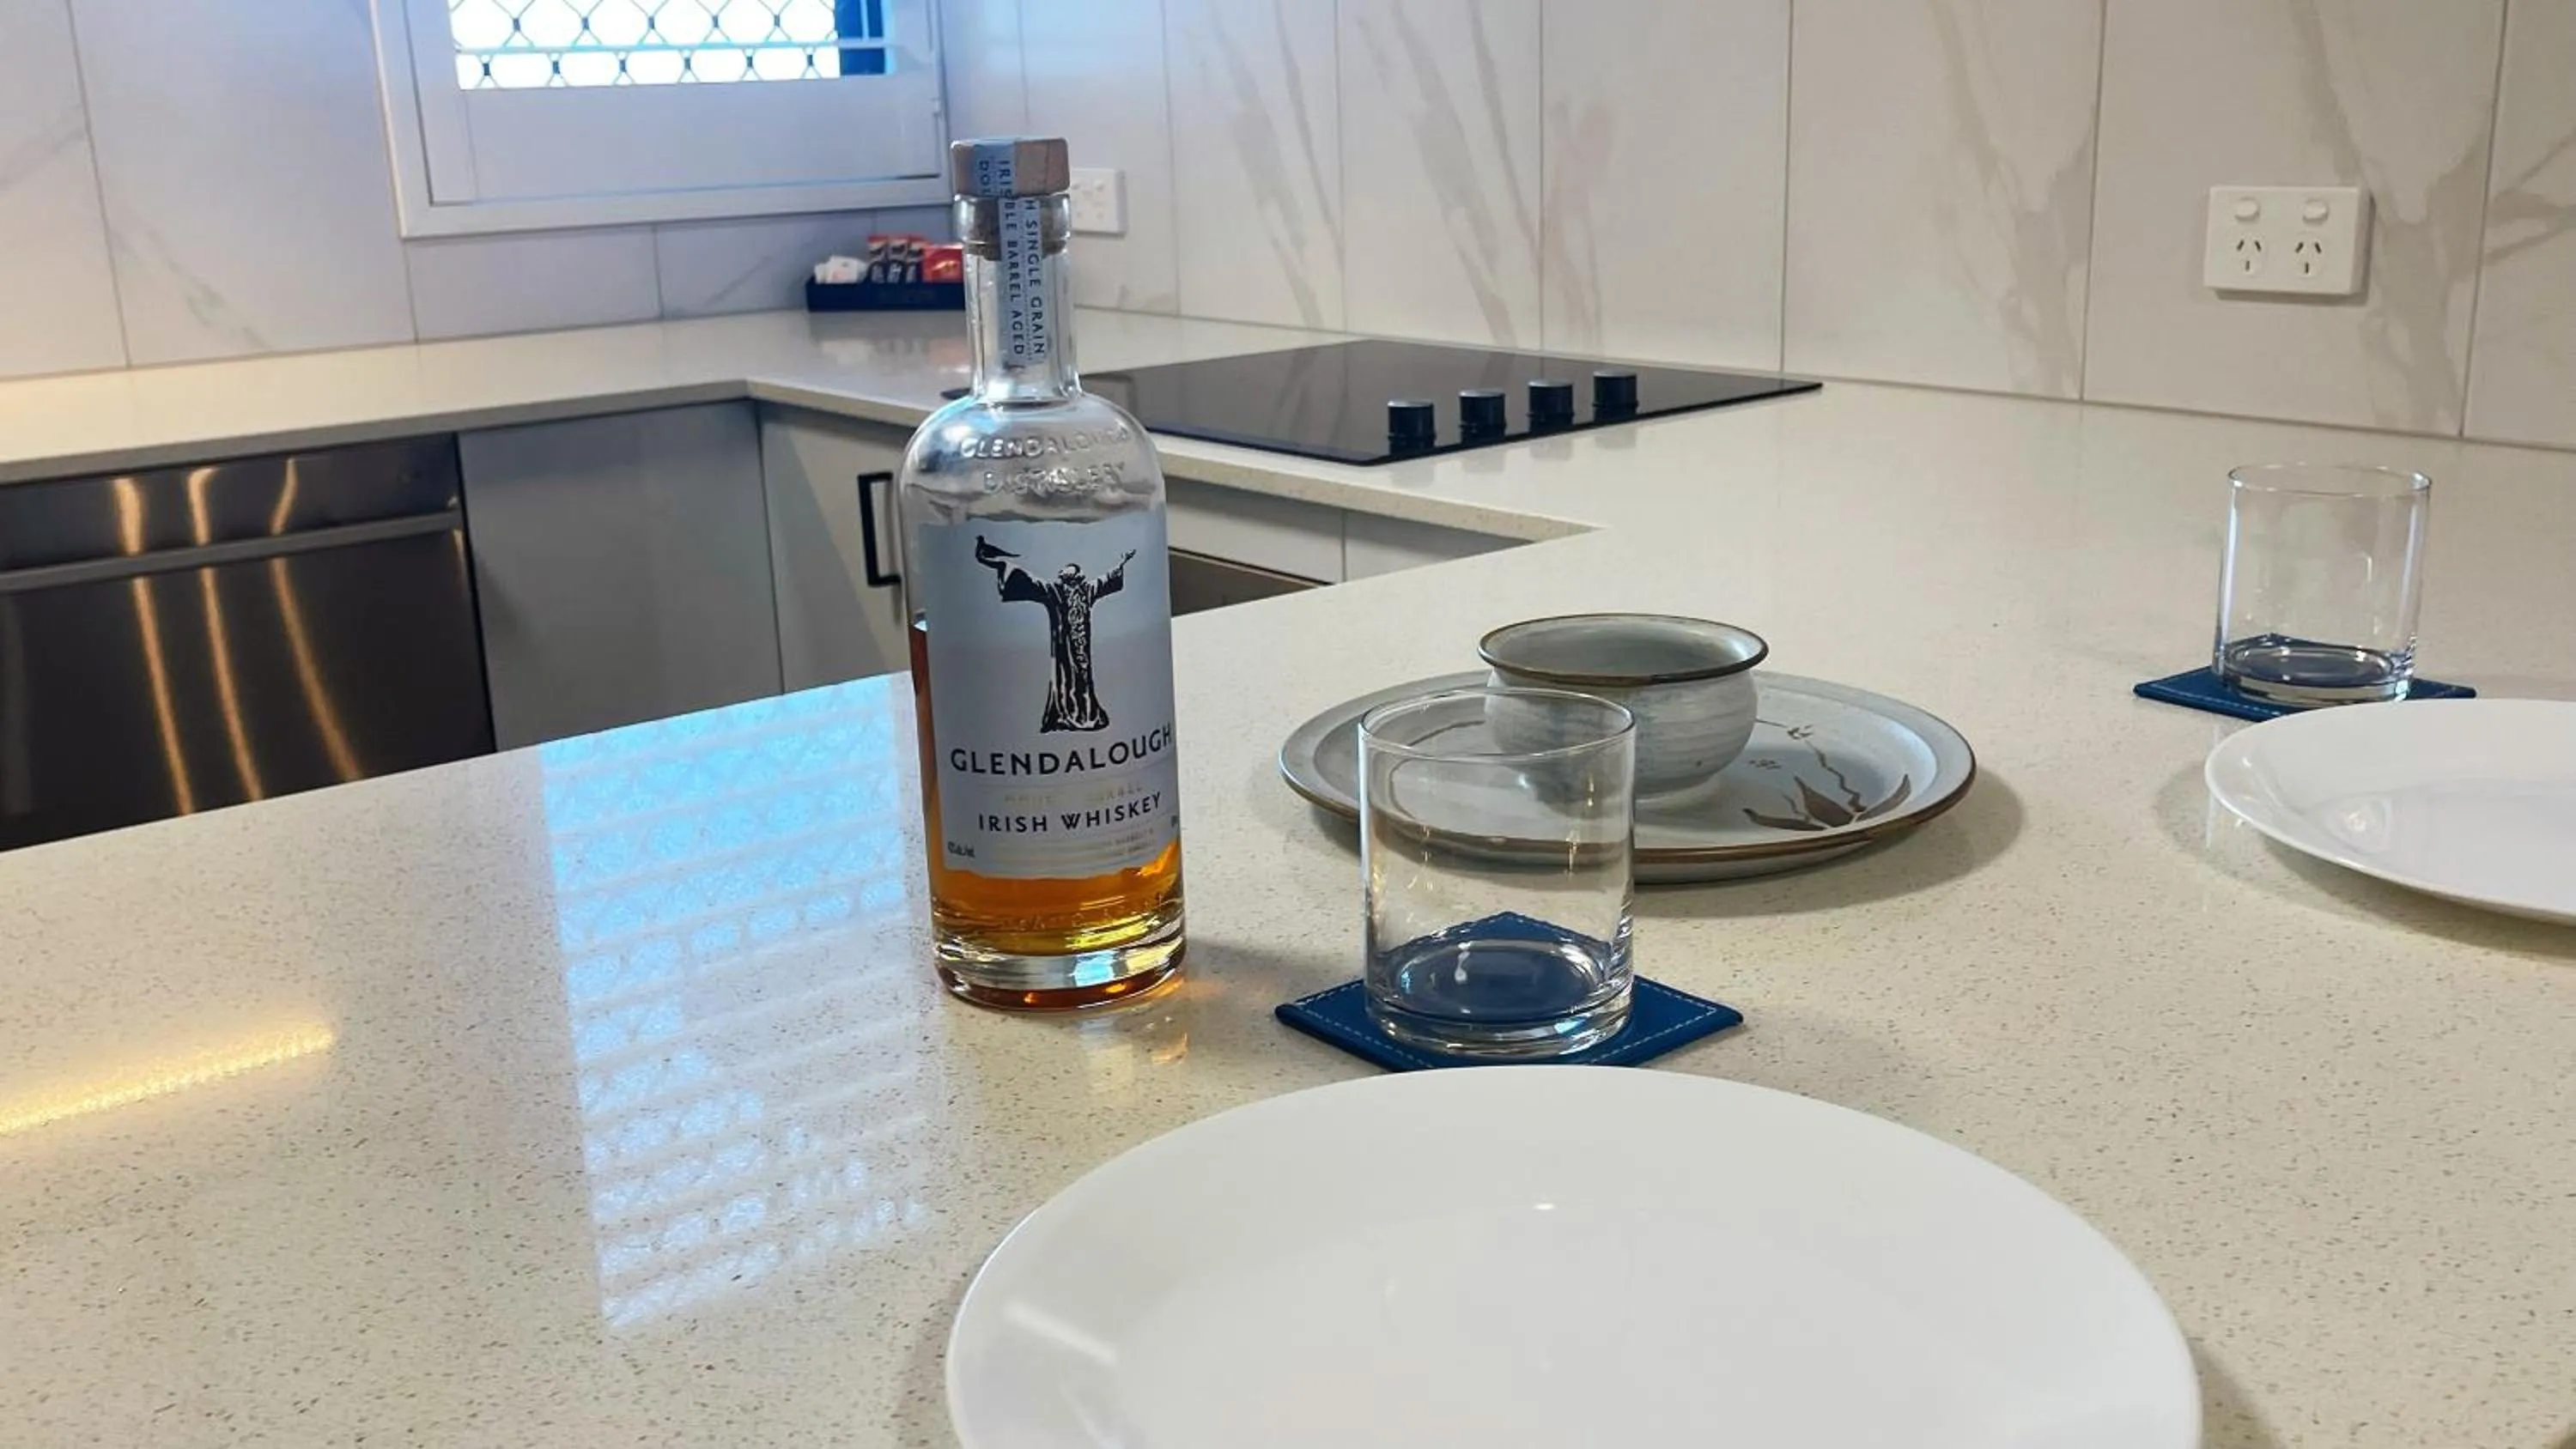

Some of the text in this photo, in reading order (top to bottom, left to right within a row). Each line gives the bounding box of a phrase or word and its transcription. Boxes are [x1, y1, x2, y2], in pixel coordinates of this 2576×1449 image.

[1006, 240, 1022, 302] BARREL
[1025, 220, 1042, 287] SINGLE
[1011, 310, 1024, 355] AGED
[1030, 296, 1045, 354] GRAIN
[951, 724, 1171, 776] GLENDALOUGH
[979, 813, 1048, 834] IRISH
[1060, 791, 1161, 831] WHISKEY
